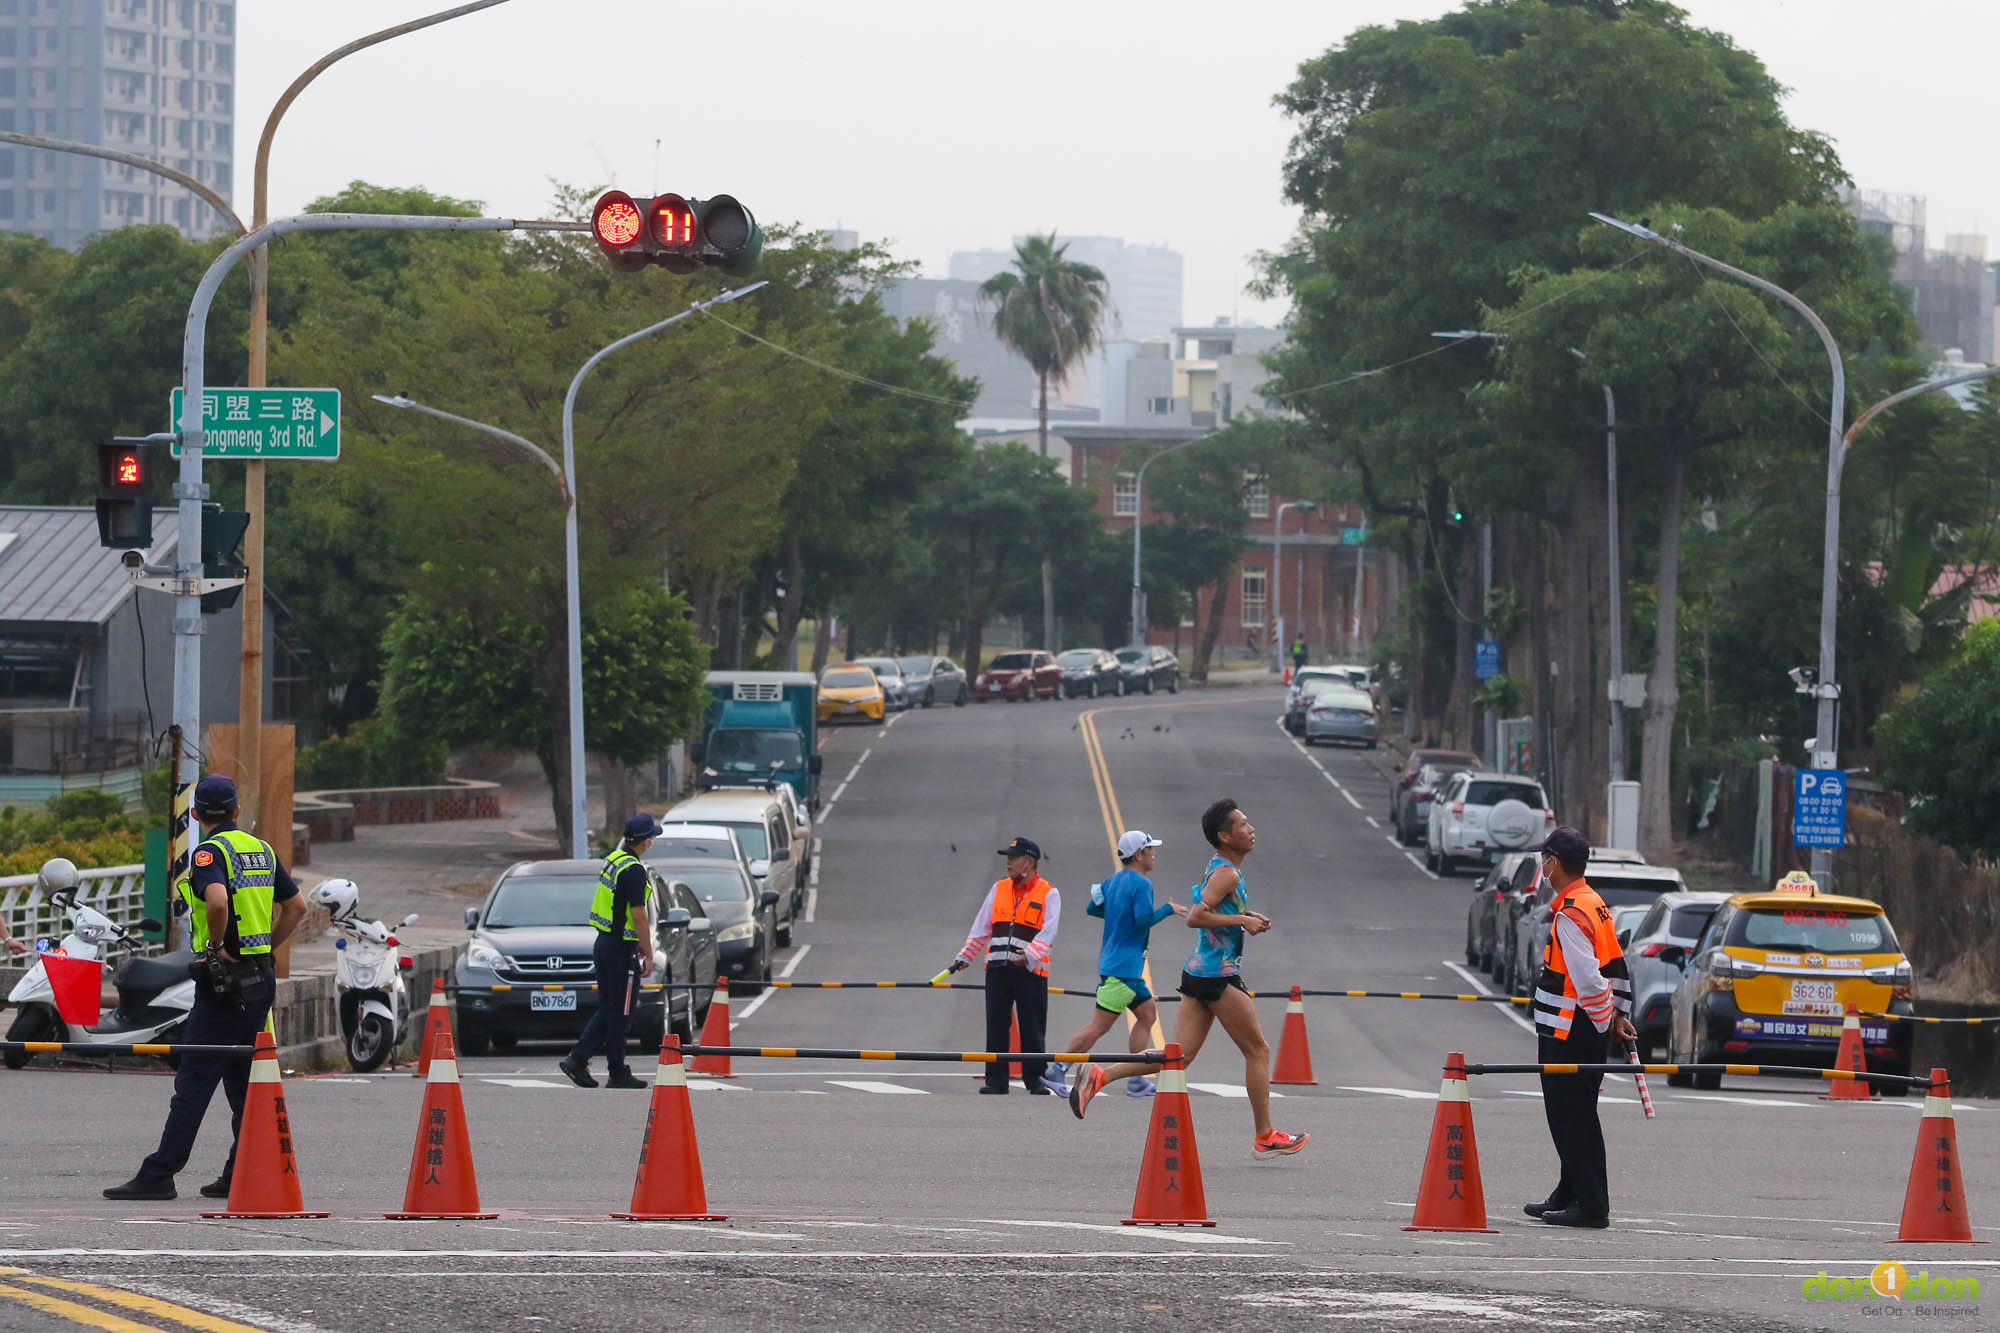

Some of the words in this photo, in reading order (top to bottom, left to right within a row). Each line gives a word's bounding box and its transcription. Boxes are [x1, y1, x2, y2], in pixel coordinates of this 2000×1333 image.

[658, 209, 692, 242] 71
[204, 429, 263, 453] ongmeng
[269, 426, 291, 448] 3rd
[1801, 773, 1817, 796] P
[424, 1107, 448, 1185] 高雄鐵人
[1162, 1114, 1180, 1192] 高雄鐵人
[1446, 1123, 1465, 1201] 高雄鐵人
